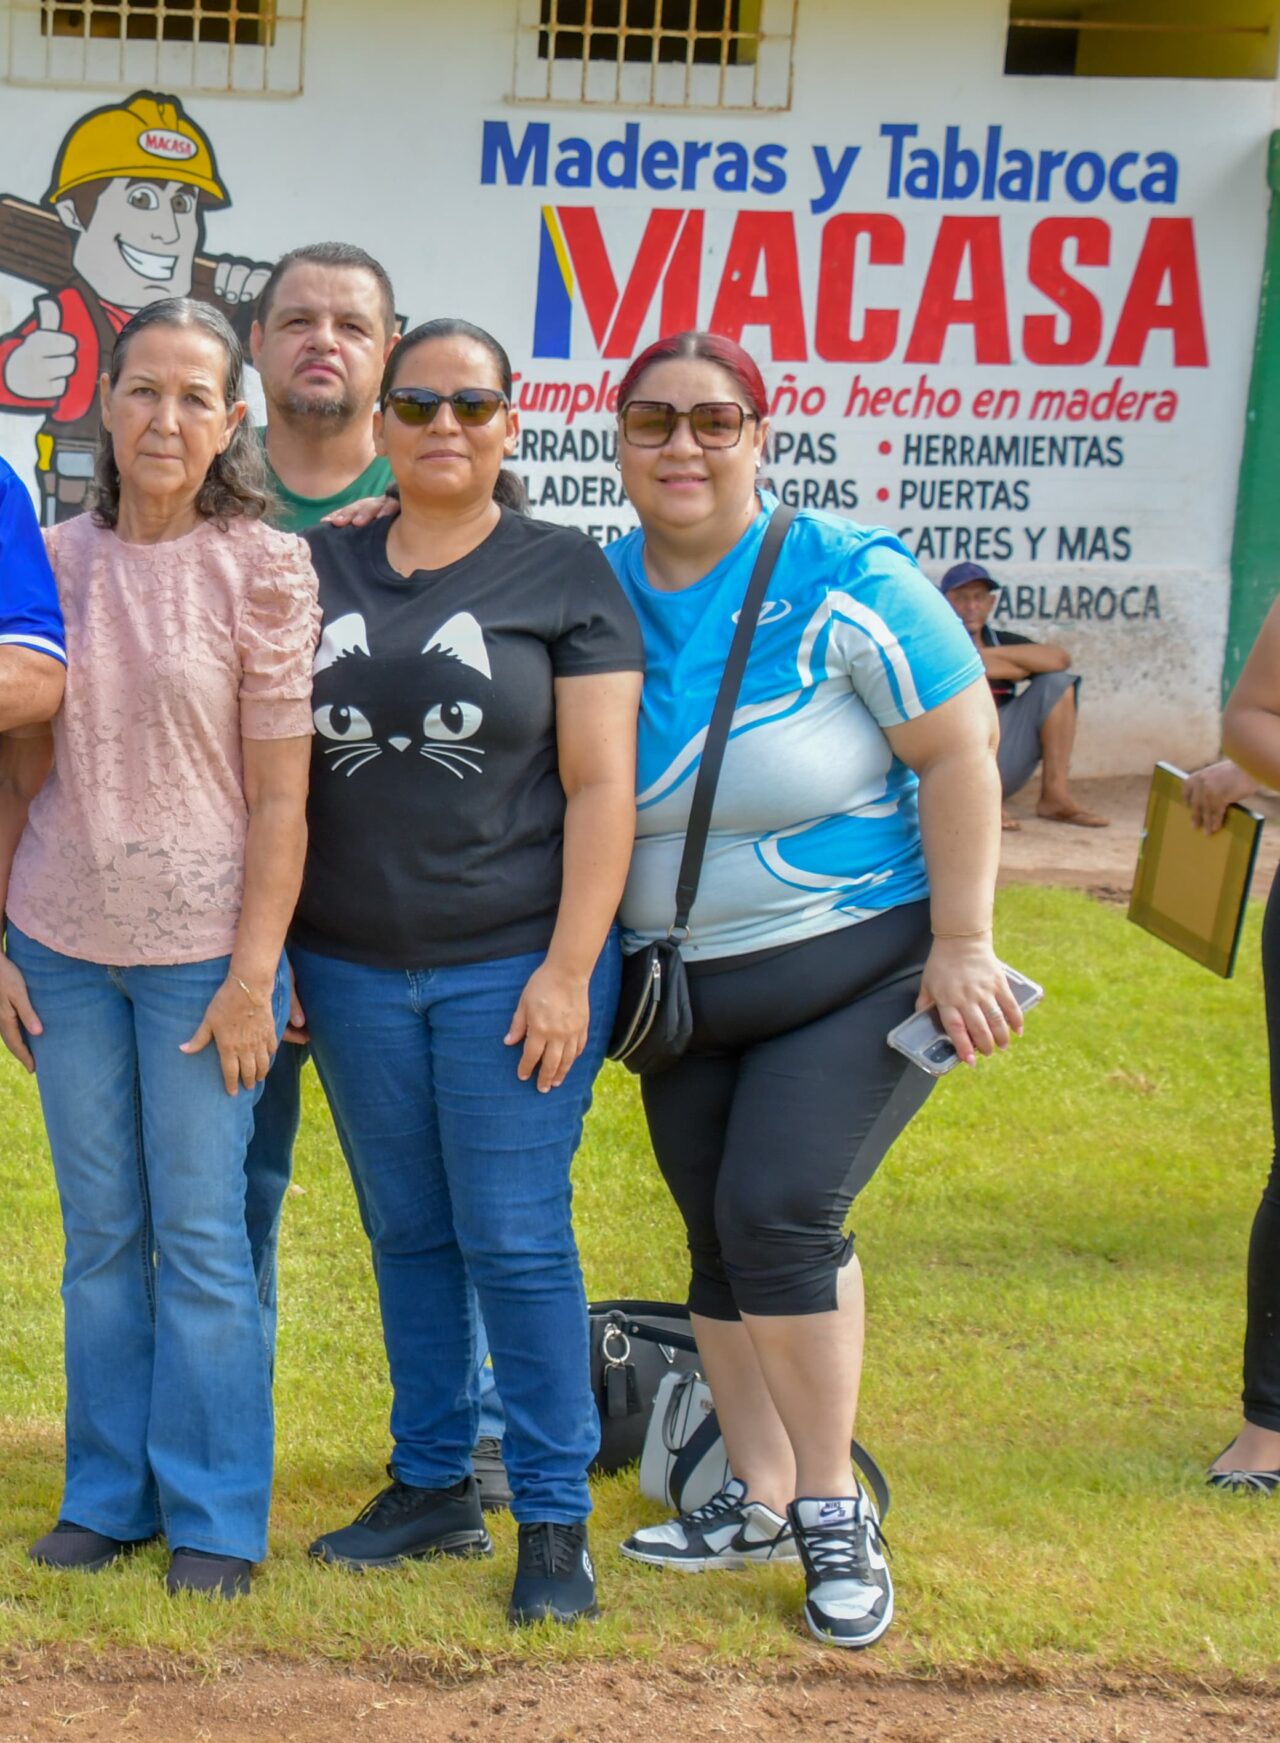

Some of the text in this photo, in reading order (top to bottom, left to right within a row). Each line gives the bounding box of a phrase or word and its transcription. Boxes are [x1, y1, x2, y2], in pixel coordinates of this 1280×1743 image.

[145, 133, 192, 155] MACASA
[480, 121, 1178, 214] Maderas y Tablaroca
[532, 205, 1208, 367] MACASA
[511, 370, 617, 424] umple
[844, 374, 962, 418] hecho
[972, 389, 1021, 418] en
[1029, 377, 1179, 423] madera
[902, 434, 1125, 467] HERRAMIENTAS
[899, 480, 1030, 511] PUERTAS
[1025, 527, 1046, 561] Y
[1057, 526, 1132, 562] MAS
[993, 585, 1161, 621] ABLAROCA
